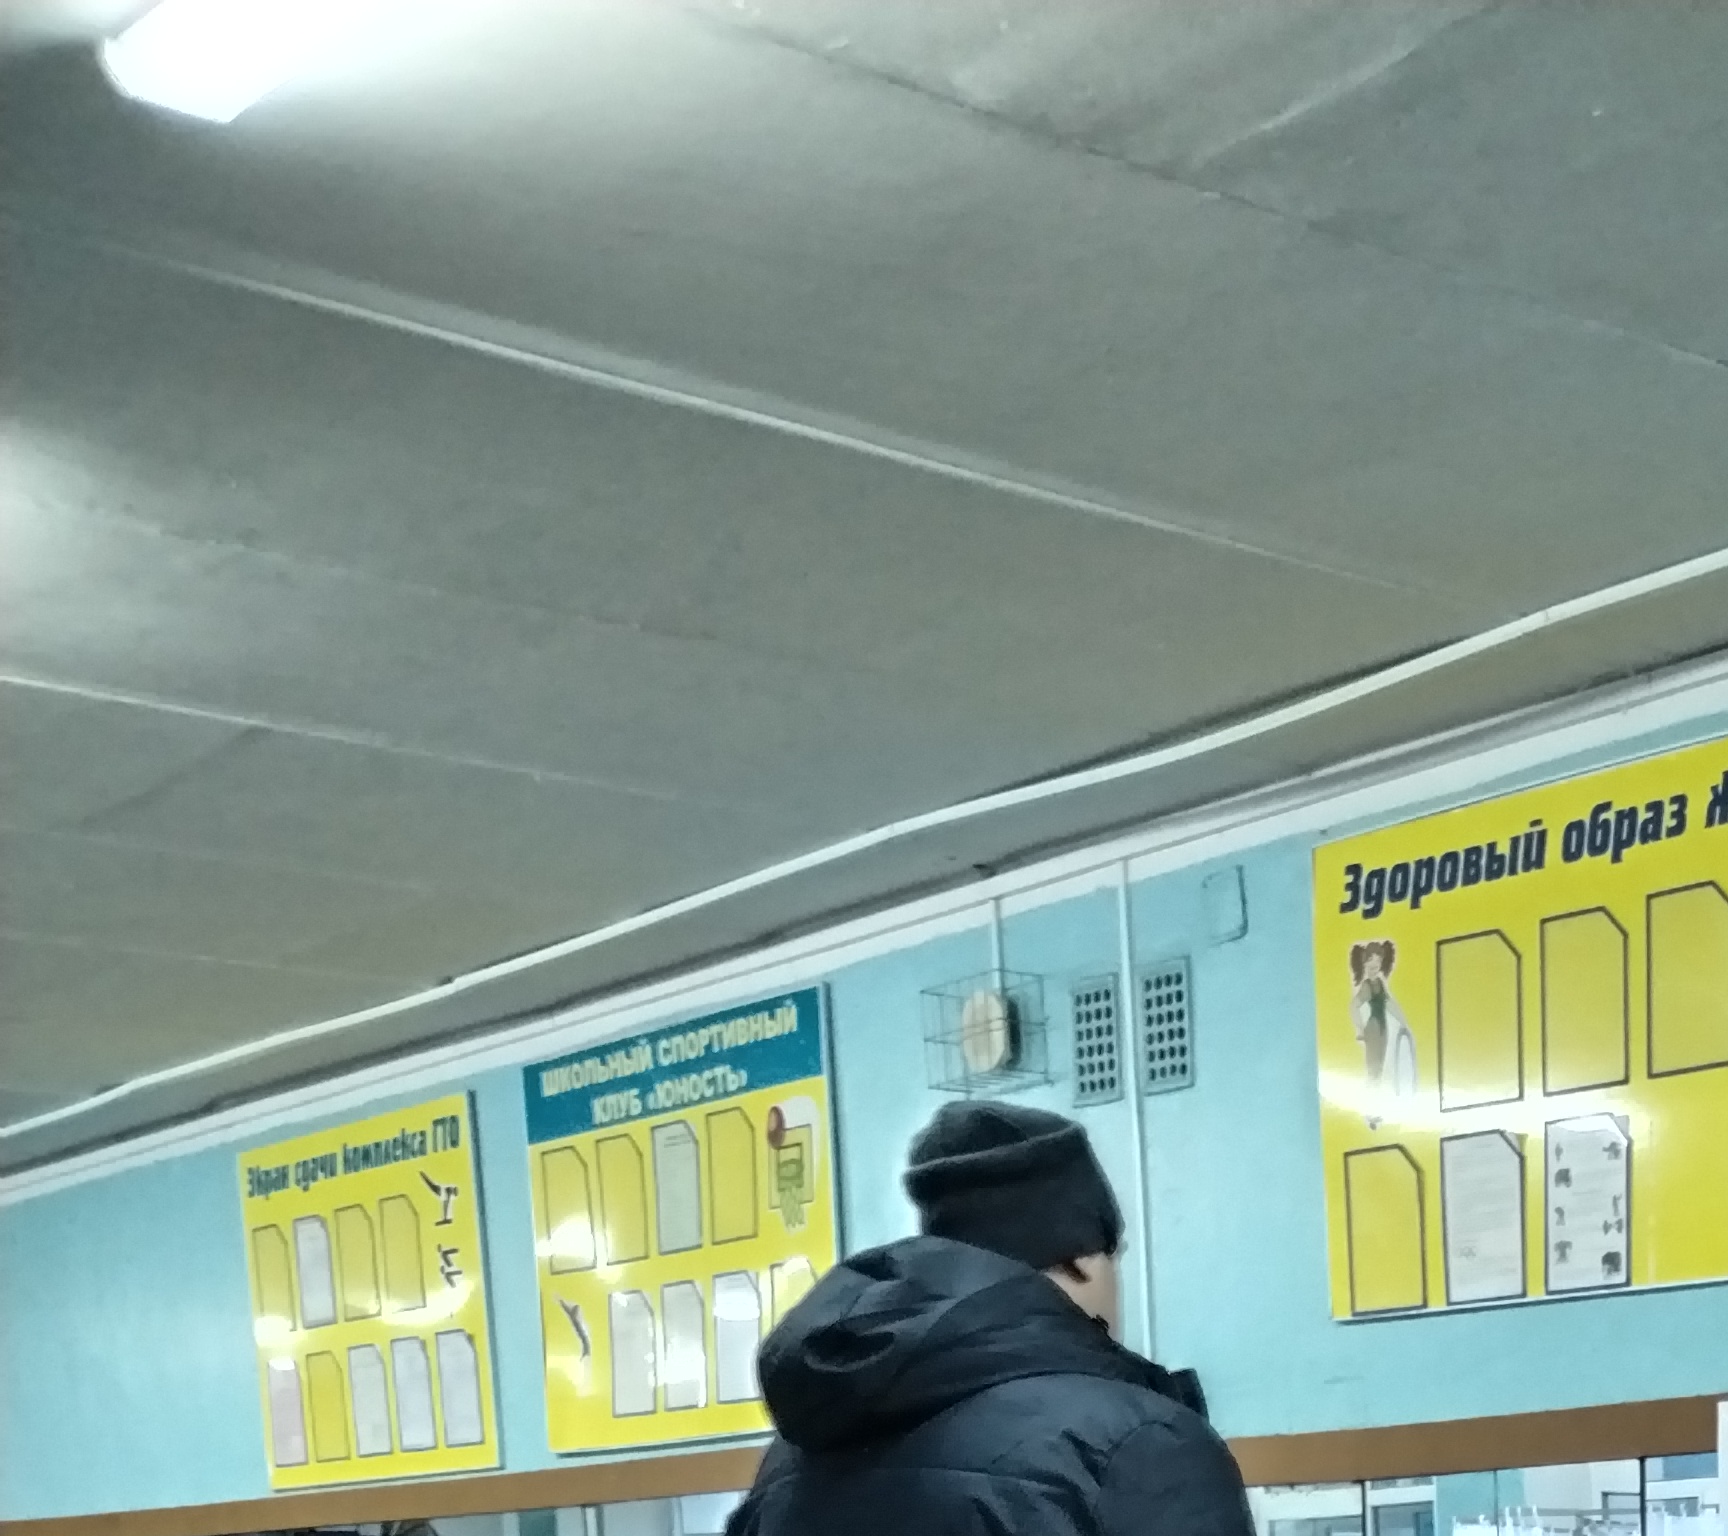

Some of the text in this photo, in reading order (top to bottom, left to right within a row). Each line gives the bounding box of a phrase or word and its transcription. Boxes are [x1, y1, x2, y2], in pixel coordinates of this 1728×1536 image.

[1339, 819, 1549, 919] Здоровый
[1561, 793, 1689, 863] образ
[541, 998, 798, 1097] ШКОЛЬНЫЙ СПОРТИВНЫЙ
[591, 1088, 642, 1125] КЛУБ
